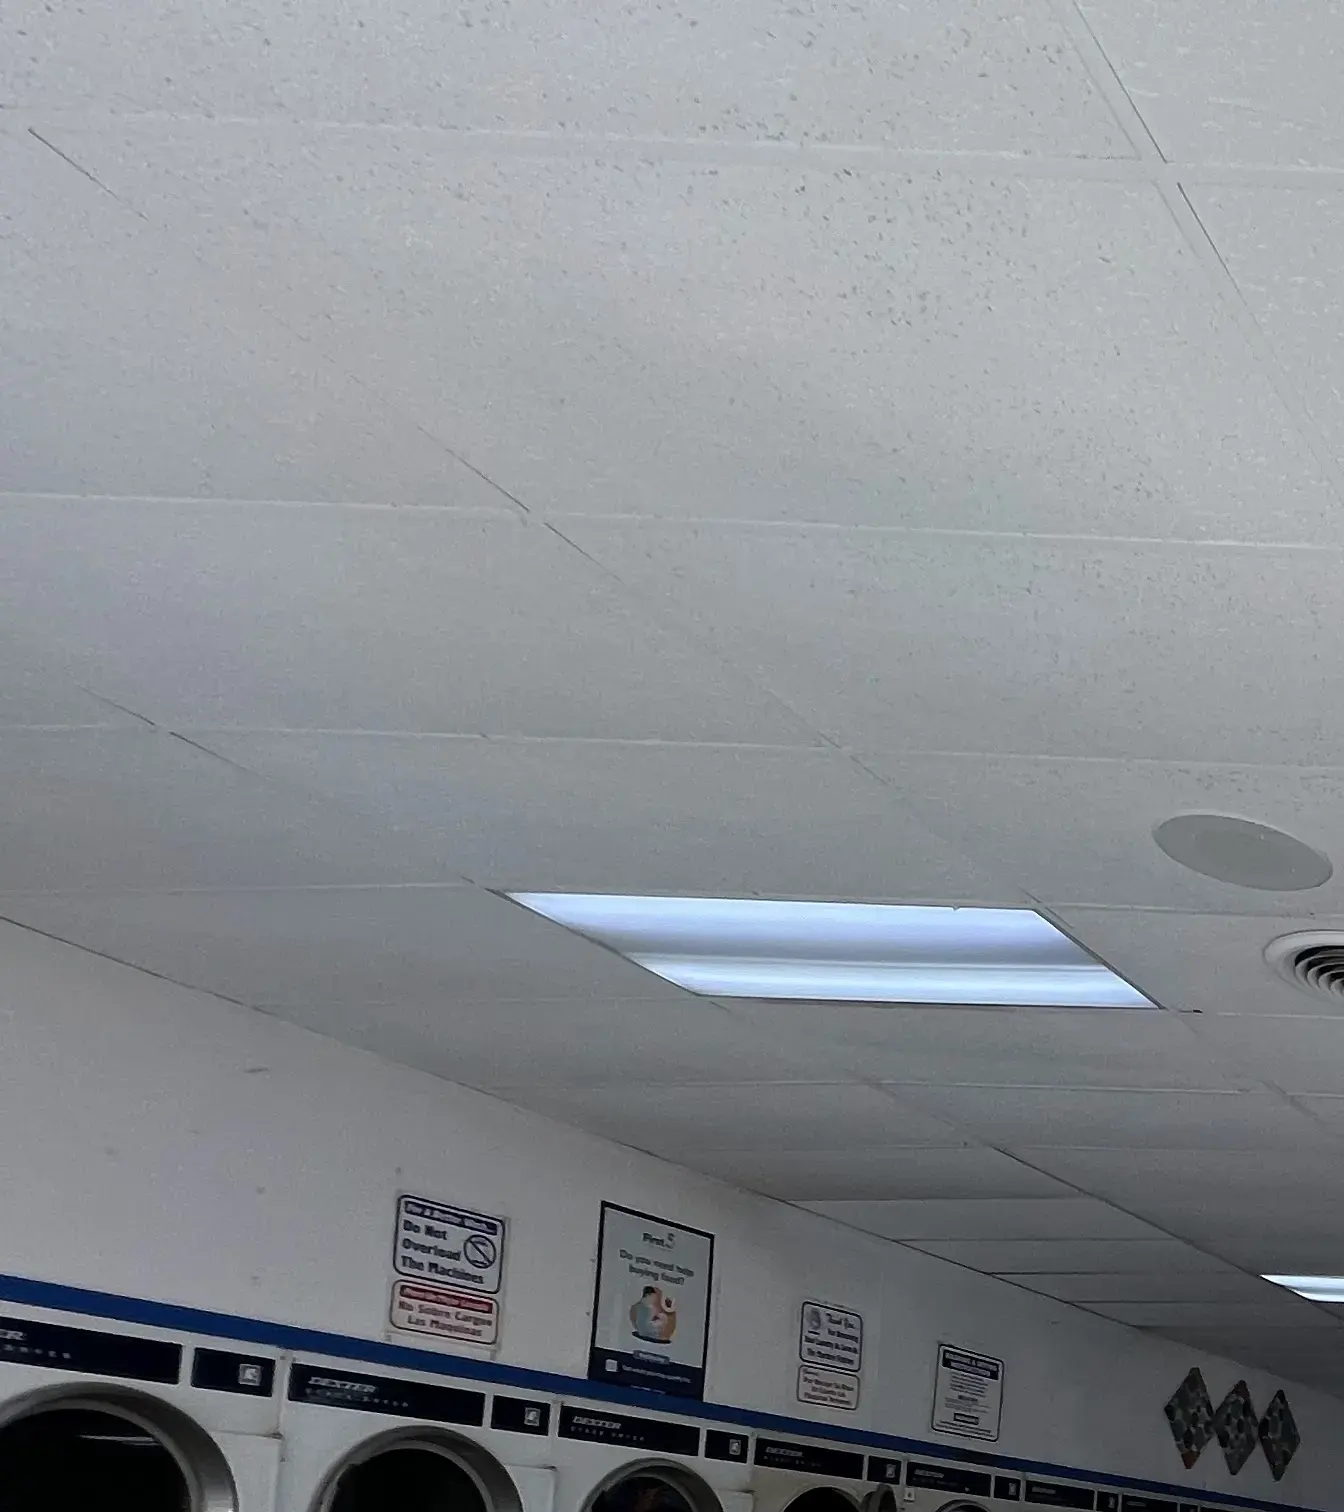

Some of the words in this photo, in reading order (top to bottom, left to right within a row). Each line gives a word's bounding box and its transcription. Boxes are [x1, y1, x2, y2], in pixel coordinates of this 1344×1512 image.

[404, 1220, 420, 1233] Do
[425, 1224, 447, 1240] Not
[402, 1238, 461, 1261] Overload
[401, 1256, 424, 1270] The
[428, 1262, 484, 1284] Machines
